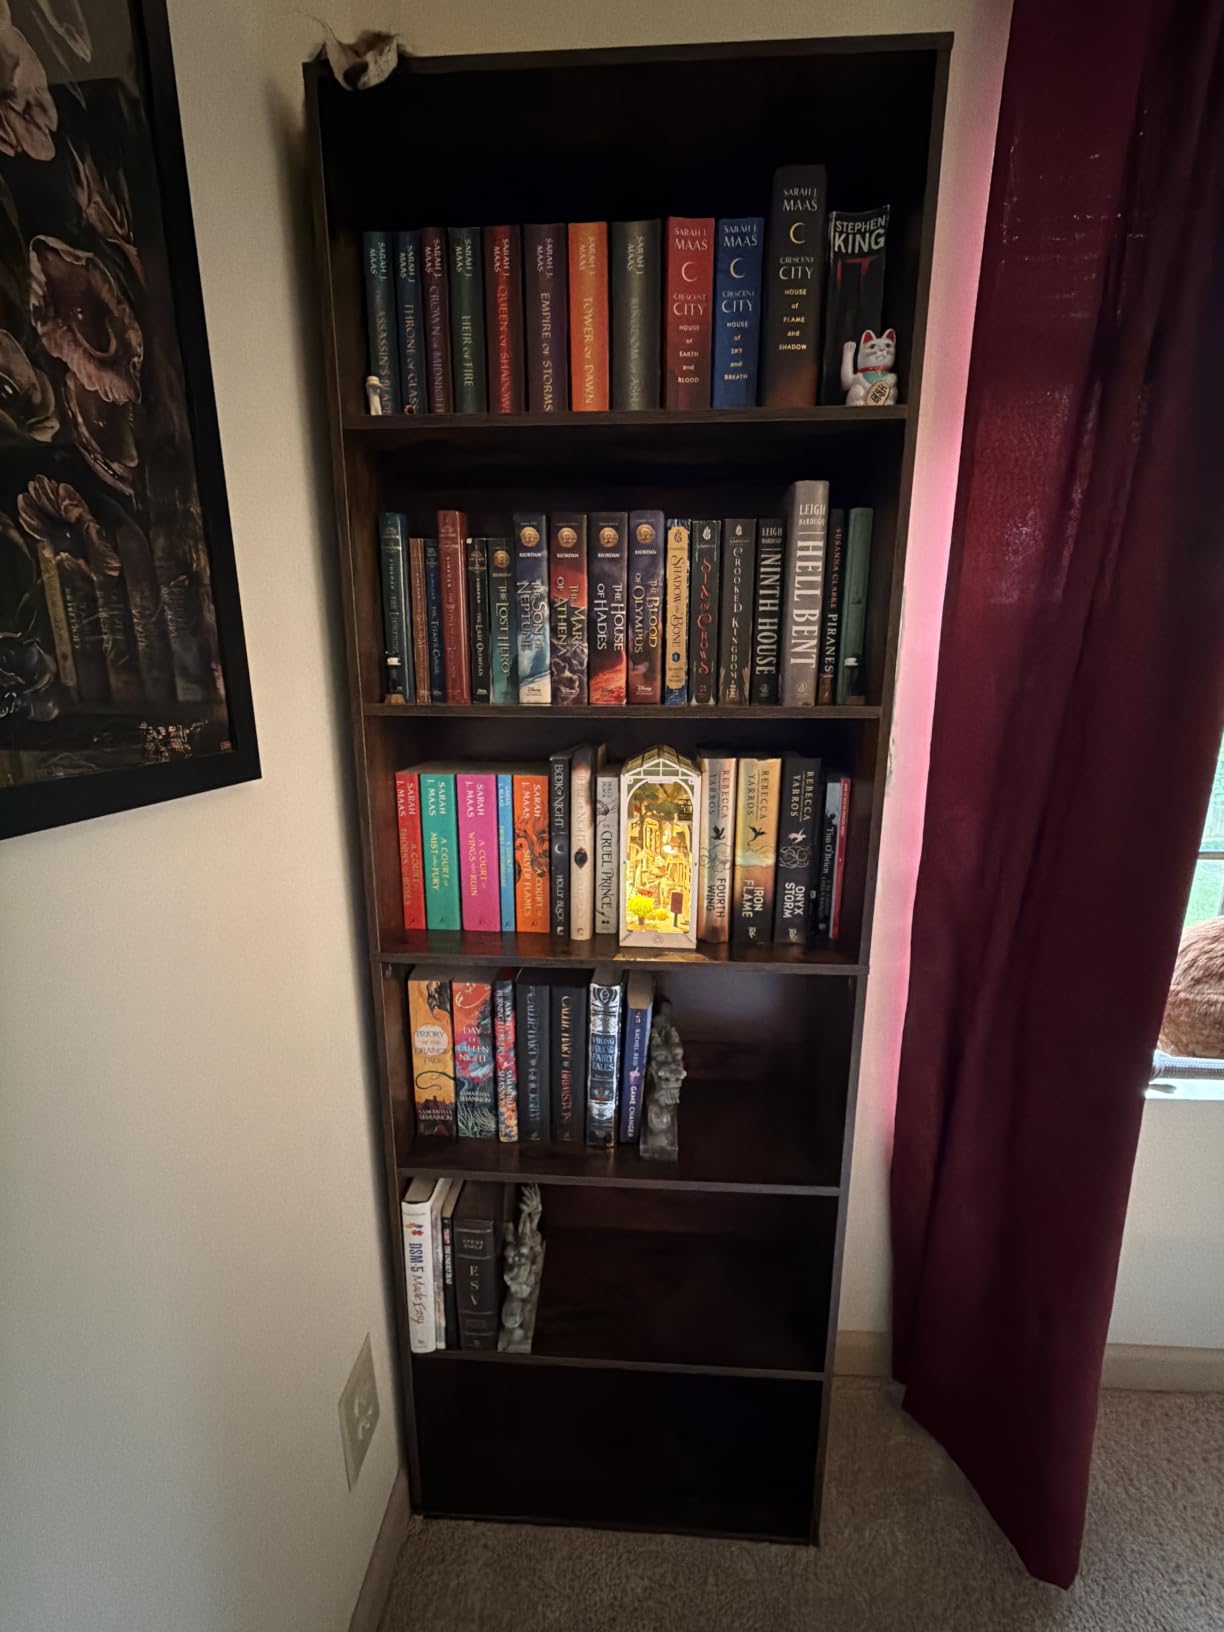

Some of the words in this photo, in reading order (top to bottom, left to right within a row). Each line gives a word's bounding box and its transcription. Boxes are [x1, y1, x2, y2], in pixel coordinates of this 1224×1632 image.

[783, 199, 818, 212] MAAS
[784, 188, 811, 197] SARAH
[674, 228, 701, 237] SARAH
[724, 224, 753, 234] SARAH
[835, 214, 886, 232] STEPHEN
[377, 242, 387, 269] SARAH
[433, 240, 441, 268] SARAH
[464, 240, 472, 269] SARAH
[502, 238, 510, 269] SARAH
[545, 237, 553, 269] SARAH
[636, 236, 644, 268] SARAH
[674, 238, 708, 250] MAAS
[724, 235, 758, 248] MAAS
[834, 228, 886, 254] KING
[369, 248, 377, 274] MAAS
[399, 252, 407, 278] MAAS
[424, 246, 432, 272] MAAS
[455, 246, 463, 272] MAAS
[493, 246, 501, 272] MAAS
[536, 245, 544, 272] MAAS
[627, 243, 635, 271] MAAS
[779, 266, 814, 280] CITY
[784, 288, 807, 296] HOUSE
[791, 302, 799, 310] of
[429, 285, 440, 337] CROWN
[497, 285, 508, 332] QUEEN
[540, 292, 551, 338] EMPIRE
[583, 296, 593, 342] TOWER
[673, 301, 705, 316] CITY
[722, 299, 753, 315] CITY
[784, 316, 806, 324] FLAME
[404, 304, 414, 353] THRONE
[461, 314, 472, 344] HEIR
[628, 296, 640, 359] KINGDOM
[787, 329, 800, 337] and
[778, 343, 807, 351] SHADOW
[464, 362, 474, 386] FIRE
[543, 360, 553, 412] STORMS
[584, 364, 594, 404] DAWN
[799, 504, 826, 515] LEIGH
[762, 527, 783, 537] LEIGH
[833, 528, 842, 571] SUSANNA
[556, 576, 564, 589] OF
[635, 572, 641, 584] OF
[671, 555, 684, 603] SHADOW
[733, 547, 743, 614] CROOKED
[758, 554, 782, 612] NINTH
[793, 540, 824, 601] HELL
[499, 585, 508, 601] THE
[568, 584, 579, 600] THE
[596, 583, 605, 598] OF
[612, 584, 623, 601] THE
[648, 578, 658, 593] THE
[831, 573, 839, 609] CLARKE
[496, 602, 509, 631] LOST
[516, 581, 532, 650] NEPTUNE
[531, 600, 547, 635] SON
[553, 594, 569, 656] ATHENA
[570, 606, 586, 650] MARK
[594, 599, 609, 650] HADES
[610, 603, 626, 651] HOUSE
[632, 585, 645, 653] OLYMPUS
[646, 595, 660, 648] BLOOD
[475, 624, 484, 641] LAST
[671, 615, 684, 647] BONE
[697, 613, 712, 675] CROWS
[790, 608, 820, 668] BENT
[824, 613, 838, 678] PIRANESI
[476, 642, 485, 677] OLYMPIAN
[498, 636, 511, 673] HERO
[755, 618, 778, 675] HOUSE
[554, 764, 564, 791] BOOK
[396, 790, 405, 816] MAAS
[407, 782, 415, 814] SARAH
[428, 788, 436, 816] MAAS
[438, 782, 446, 814] SARAH
[466, 790, 475, 818] MAAS
[476, 784, 484, 816] SARAH
[522, 791, 531, 819] MAAS
[709, 774, 718, 816] YARROS
[721, 769, 730, 819] REBECCA
[747, 774, 756, 816] YARROS
[760, 770, 769, 820] REBECCA
[790, 774, 800, 817] YARROS
[804, 770, 815, 821] REBECCA
[553, 795, 564, 828] NIGHT
[430, 832, 438, 854] MIST
[468, 832, 476, 862] WINGS
[478, 839, 485, 847] A
[600, 830, 613, 867] CRUEL
[825, 826, 834, 843] Tim
[441, 847, 449, 878] COURT
[479, 849, 487, 881] COURT
[523, 848, 531, 880] SILVER
[823, 844, 834, 874] O'Brien
[432, 867, 440, 890] FURY
[470, 874, 478, 896] RUIN
[536, 878, 544, 907] COURT
[556, 874, 564, 898] HOLLY
[600, 871, 614, 909] PRINCE
[523, 882, 532, 917] FLAMES
[555, 900, 564, 922] BLACK
[706, 884, 716, 912] WING
[717, 878, 726, 918] FOURTH
[741, 879, 753, 918] FLAME
[754, 886, 764, 911] IRON
[782, 882, 795, 918] STORM
[794, 886, 805, 915] ONYX
[463, 1026, 482, 1035] DAY
[633, 1028, 641, 1050] RACHEL
[458, 1053, 486, 1062] NIGHT
[592, 1054, 614, 1062] FAIRY
[592, 1062, 614, 1072] TALES
[629, 1086, 638, 1105] GAME
[628, 1106, 636, 1137] CHANGER
[409, 1243, 424, 1272] DSM-5
[412, 1275, 424, 1300] Made
[470, 1265, 479, 1306] ESV
[411, 1302, 426, 1324] Easy
